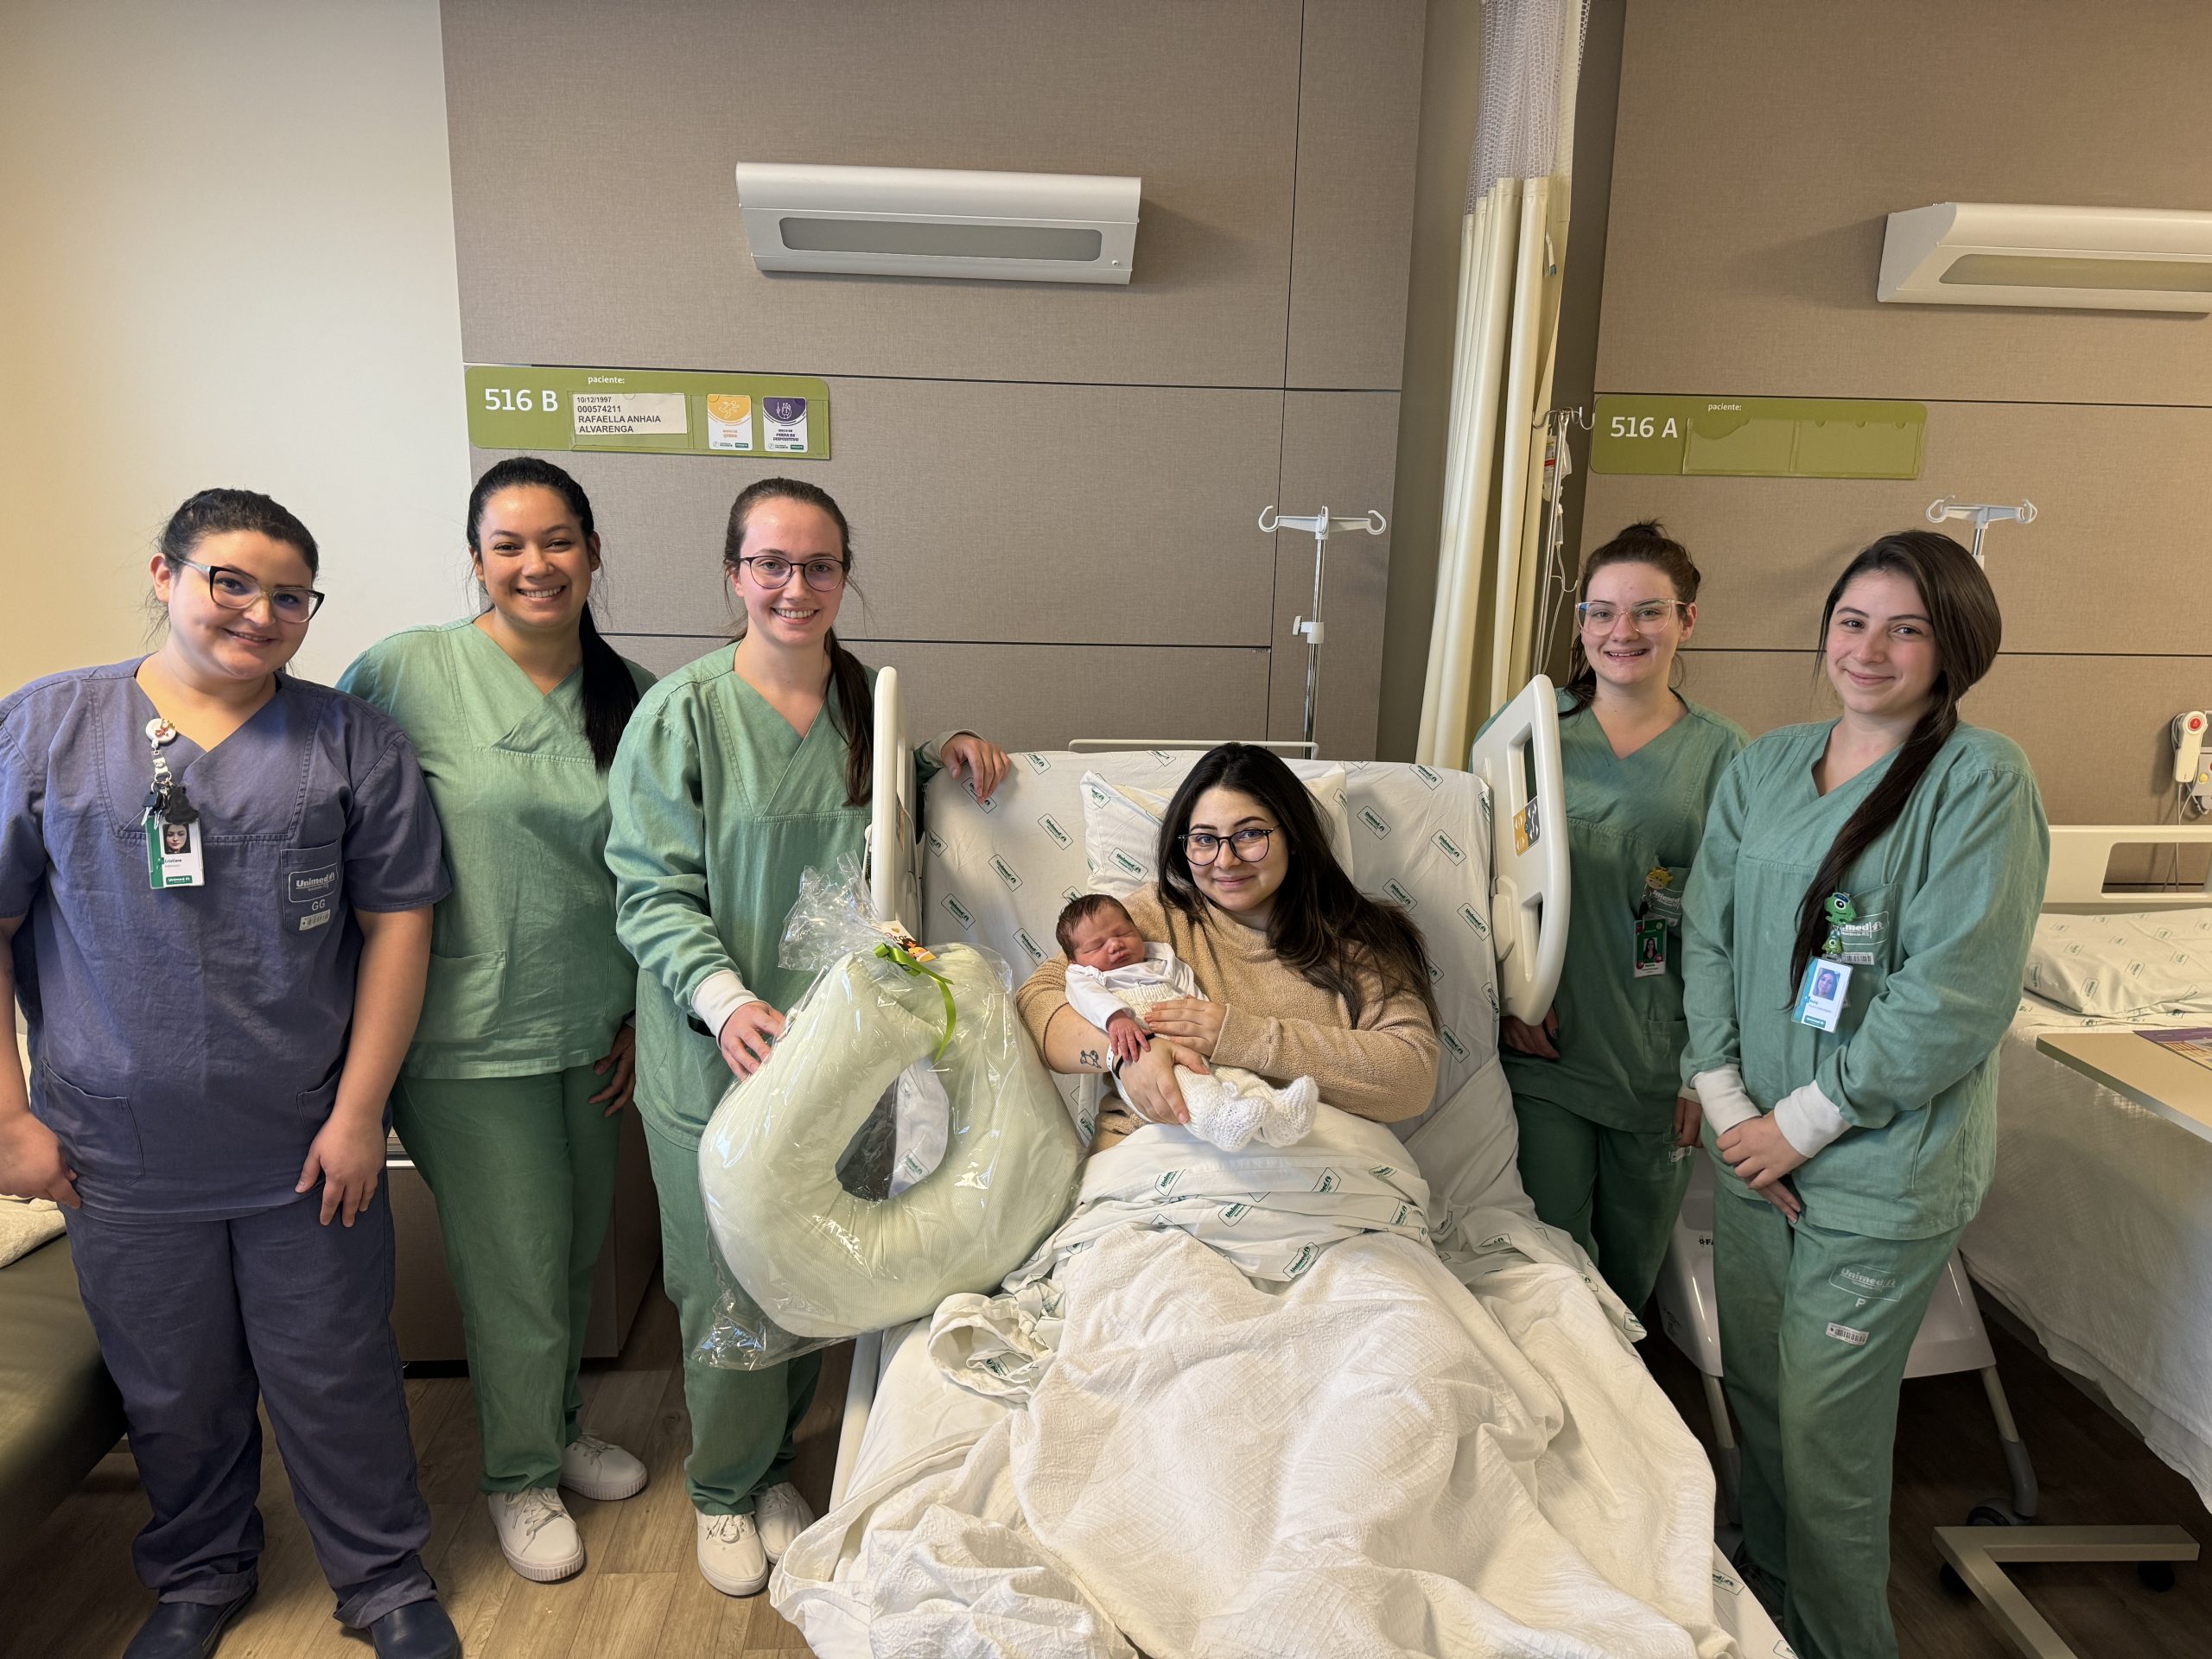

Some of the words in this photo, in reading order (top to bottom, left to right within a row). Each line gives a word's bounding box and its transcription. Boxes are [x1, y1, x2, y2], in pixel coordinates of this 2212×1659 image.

[588, 376, 625, 385] paciente:
[485, 388, 533, 411] 516
[542, 390, 558, 412] B
[1707, 403, 1742, 412] paciente:
[1610, 416, 1654, 438] 516
[1661, 417, 1678, 438] A
[296, 874, 328, 887] Unimed
[312, 899, 326, 911] GG
[1840, 1268, 1884, 1286] Unimed
[1855, 1297, 1866, 1307] P
